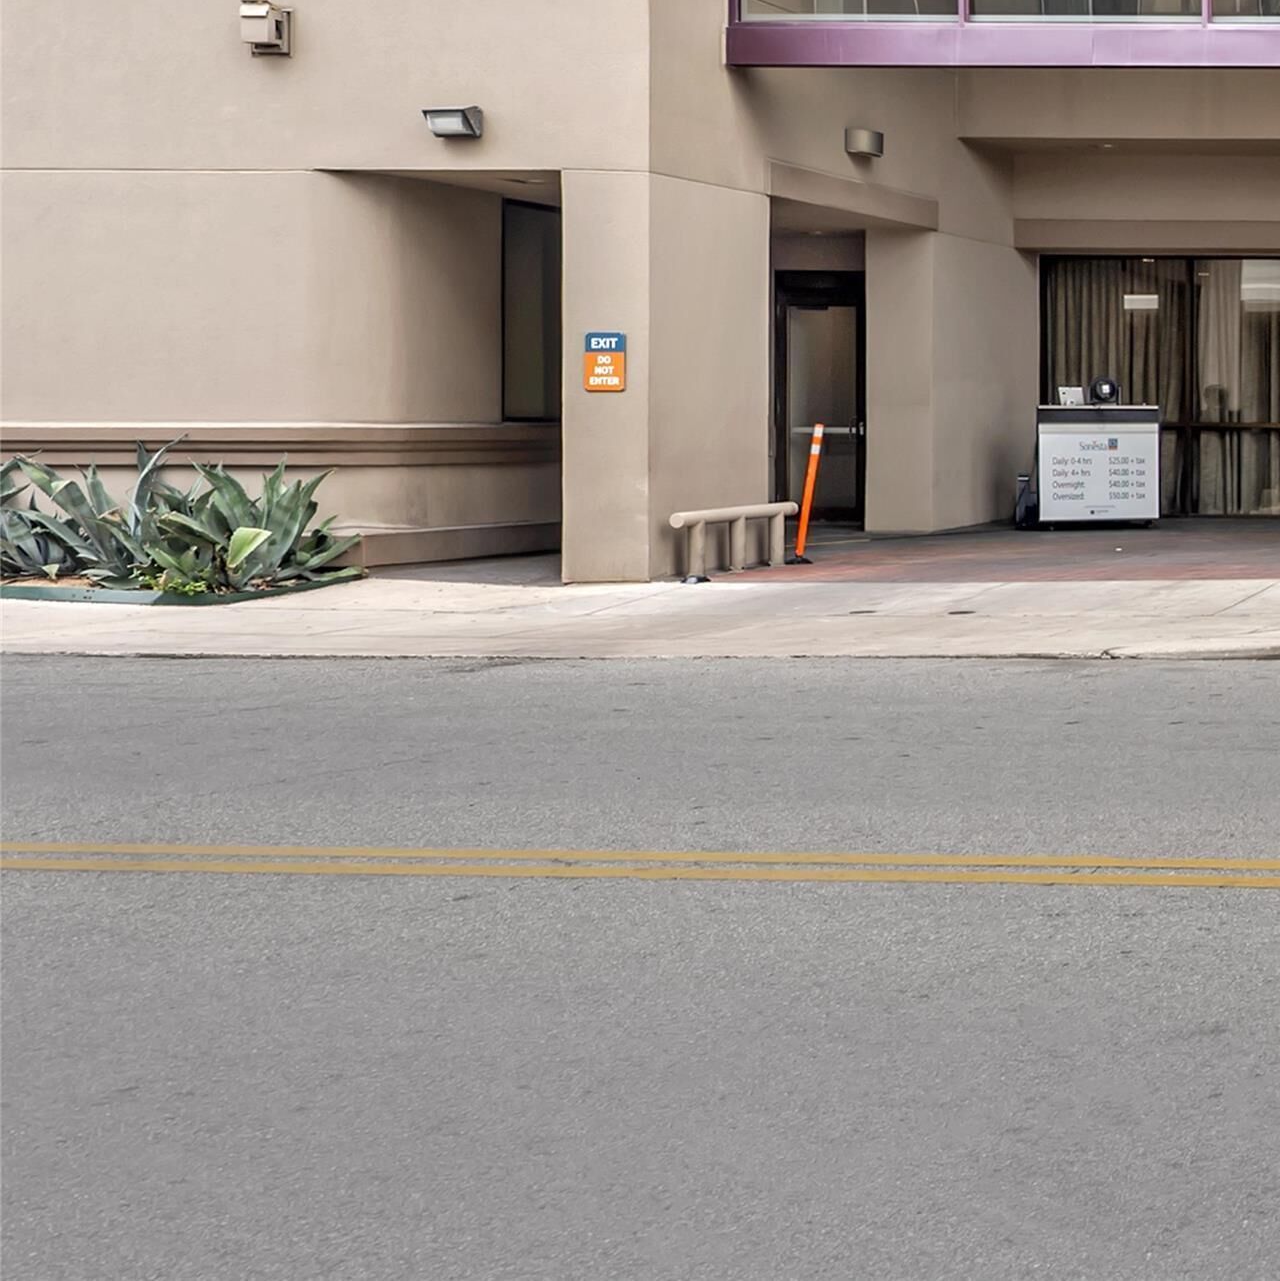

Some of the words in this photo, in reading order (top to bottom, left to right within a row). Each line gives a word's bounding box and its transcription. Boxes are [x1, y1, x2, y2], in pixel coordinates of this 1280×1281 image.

[591, 337, 619, 349] EXIT
[597, 355, 612, 364] DO
[594, 365, 615, 375] NOT
[589, 376, 620, 386] ENTER
